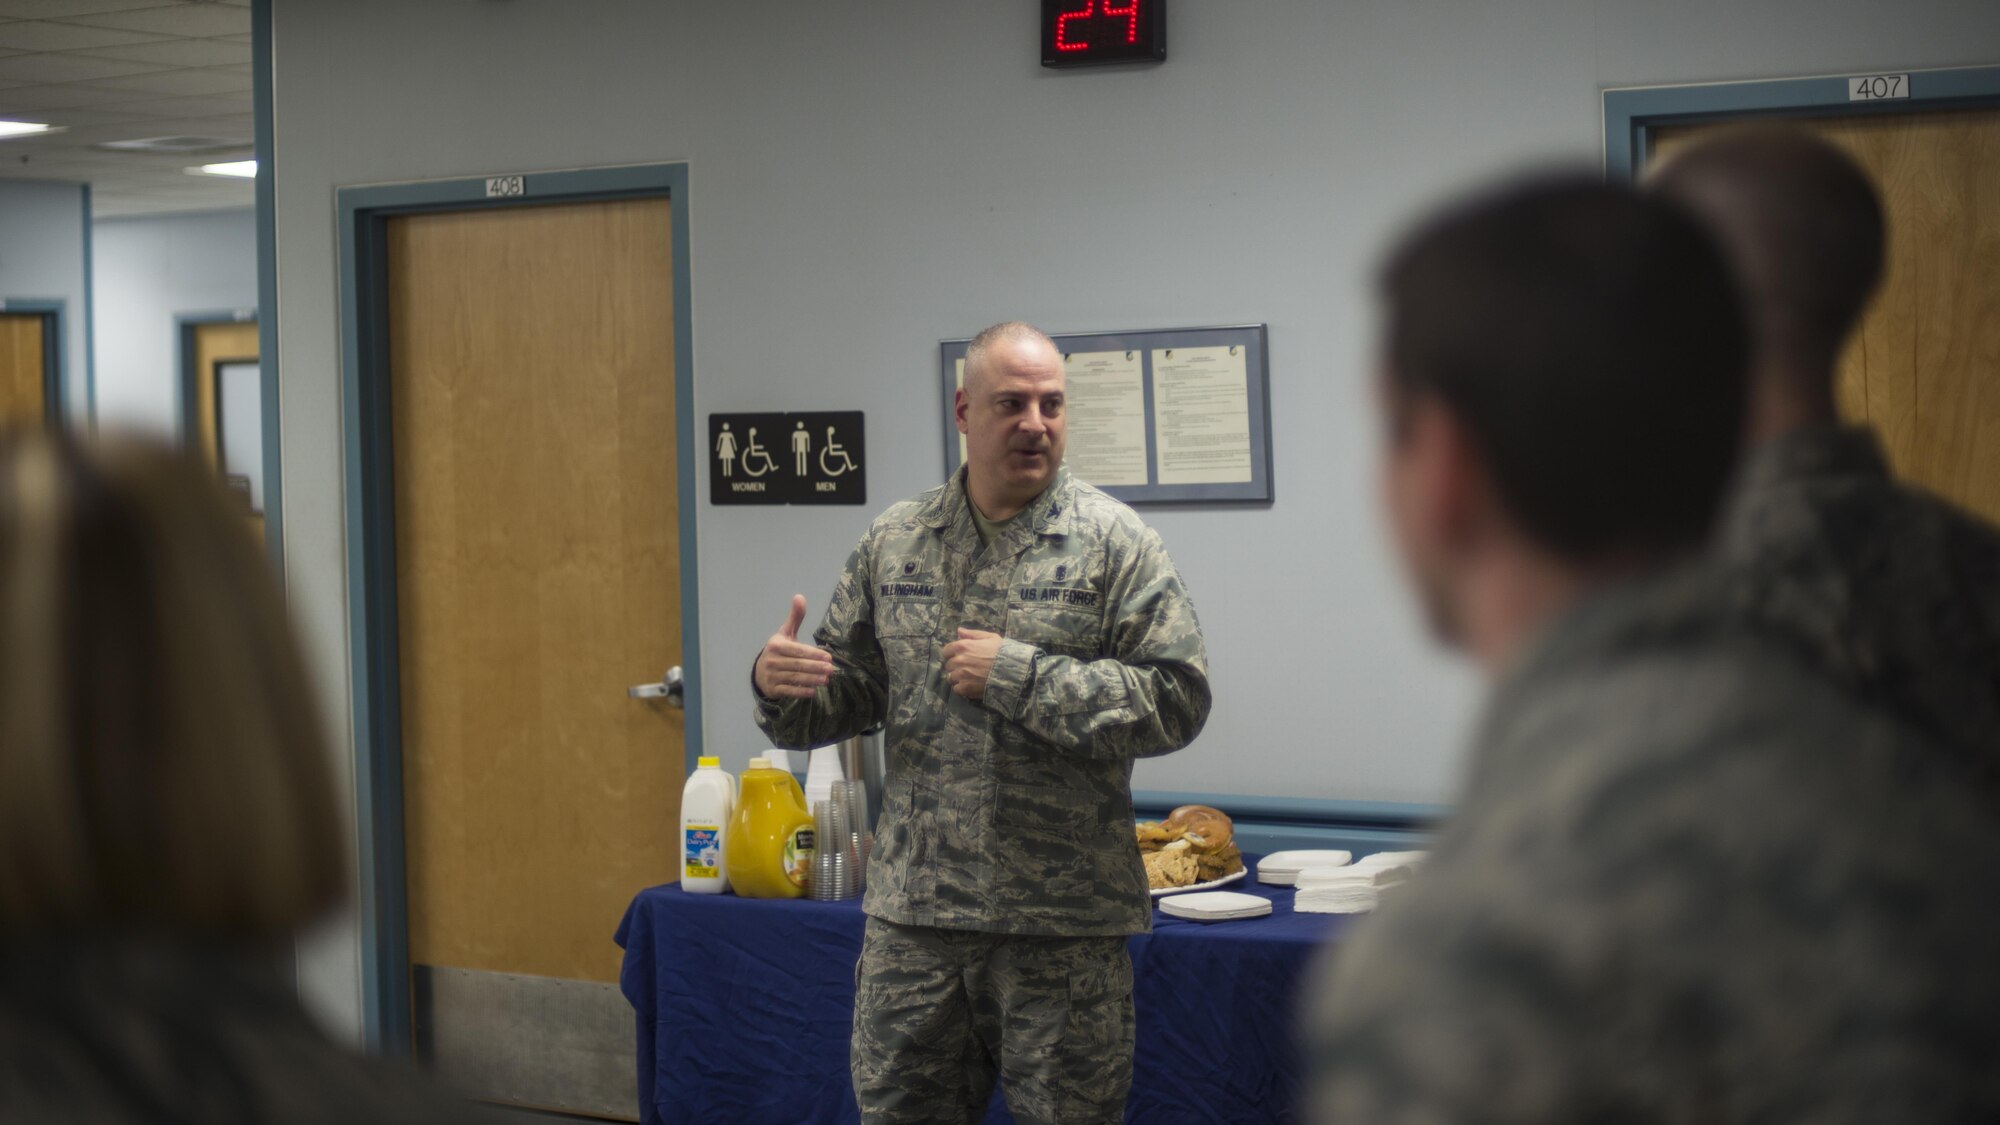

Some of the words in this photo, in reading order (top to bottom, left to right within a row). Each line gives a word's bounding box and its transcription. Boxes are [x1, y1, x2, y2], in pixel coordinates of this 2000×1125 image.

[1857, 76, 1901, 98] 407
[490, 177, 520, 196] 408
[731, 482, 766, 492] WOMEN
[815, 482, 836, 492] MEN
[1040, 588, 1060, 601] AIR
[1062, 588, 1098, 606] FORCE
